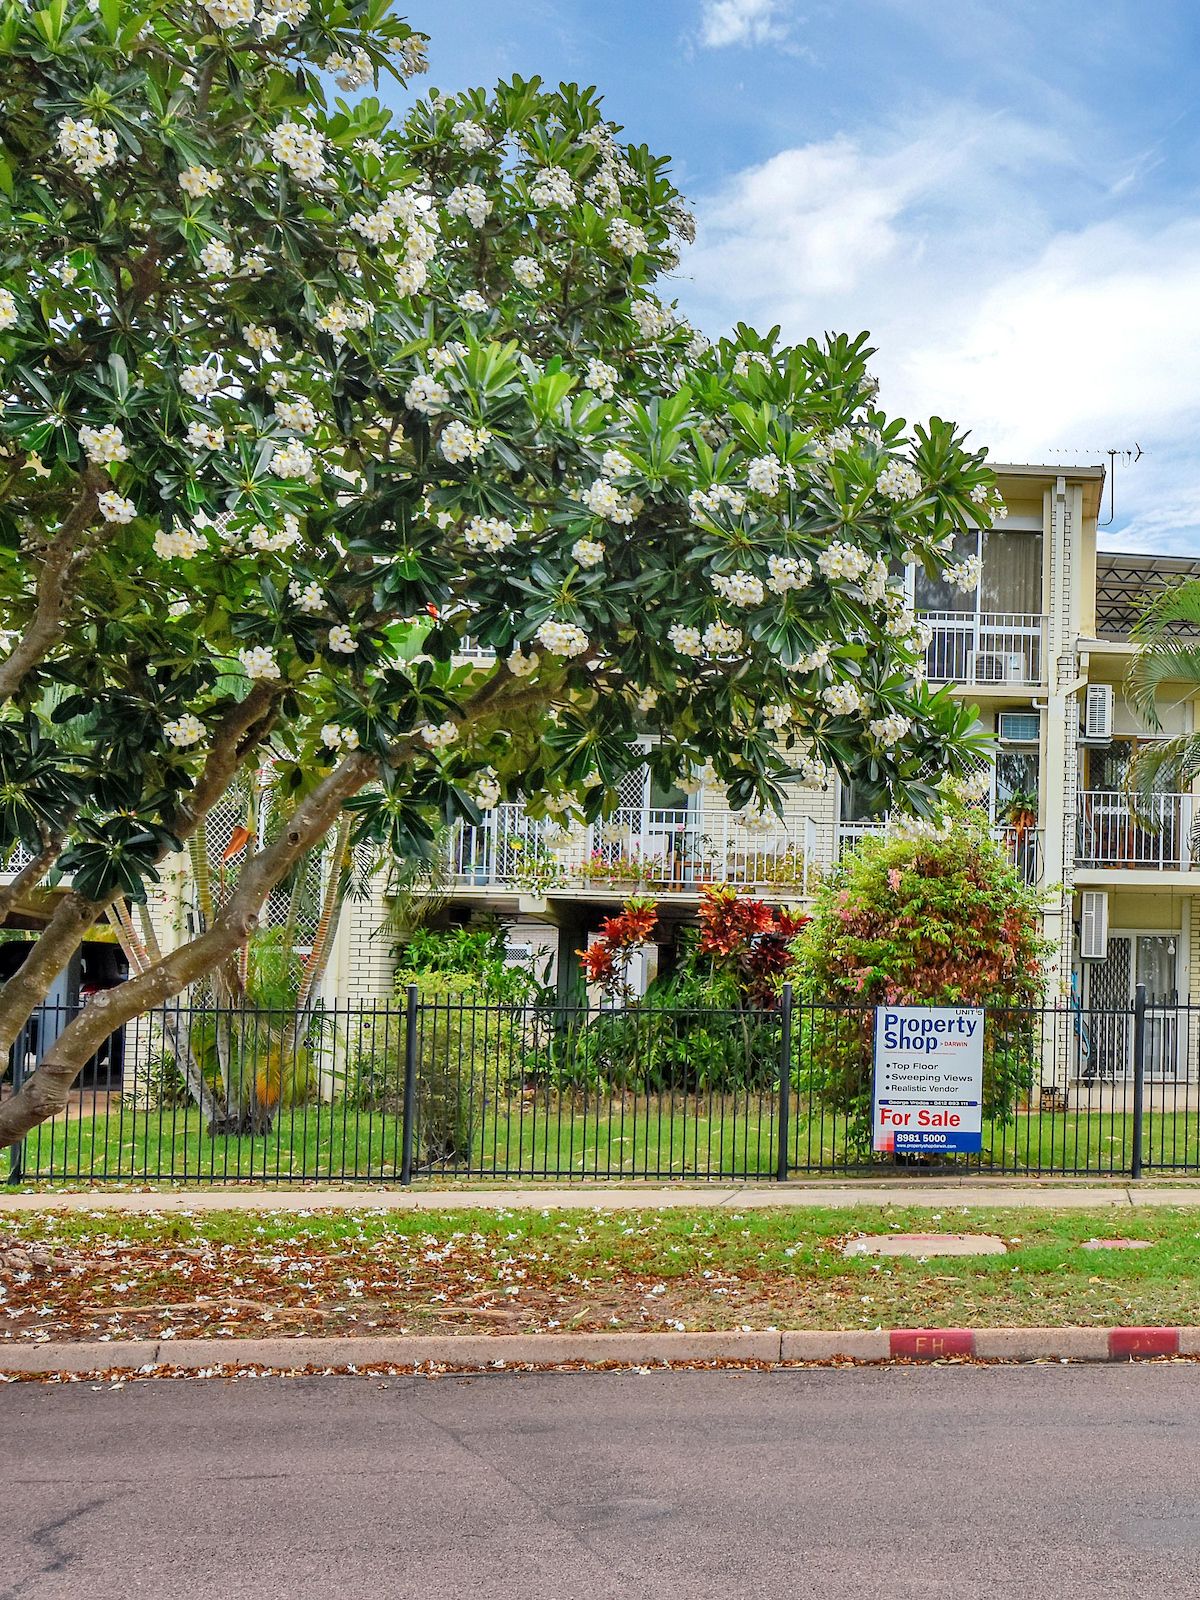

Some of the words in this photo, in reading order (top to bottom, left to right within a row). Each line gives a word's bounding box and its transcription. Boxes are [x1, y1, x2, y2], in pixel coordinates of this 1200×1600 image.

[884, 1014, 977, 1037] Property
[884, 1031, 938, 1054] Shop
[892, 1062, 910, 1071] Top
[913, 1062, 939, 1070] Floor
[891, 1073, 941, 1083] Sweeping
[943, 1074, 973, 1082] Views
[929, 1085, 959, 1093] Vendor
[880, 1108, 911, 1126] For
[917, 1110, 961, 1127] Sale
[896, 1133, 921, 1143] 8981
[922, 1134, 947, 1143] 5000
